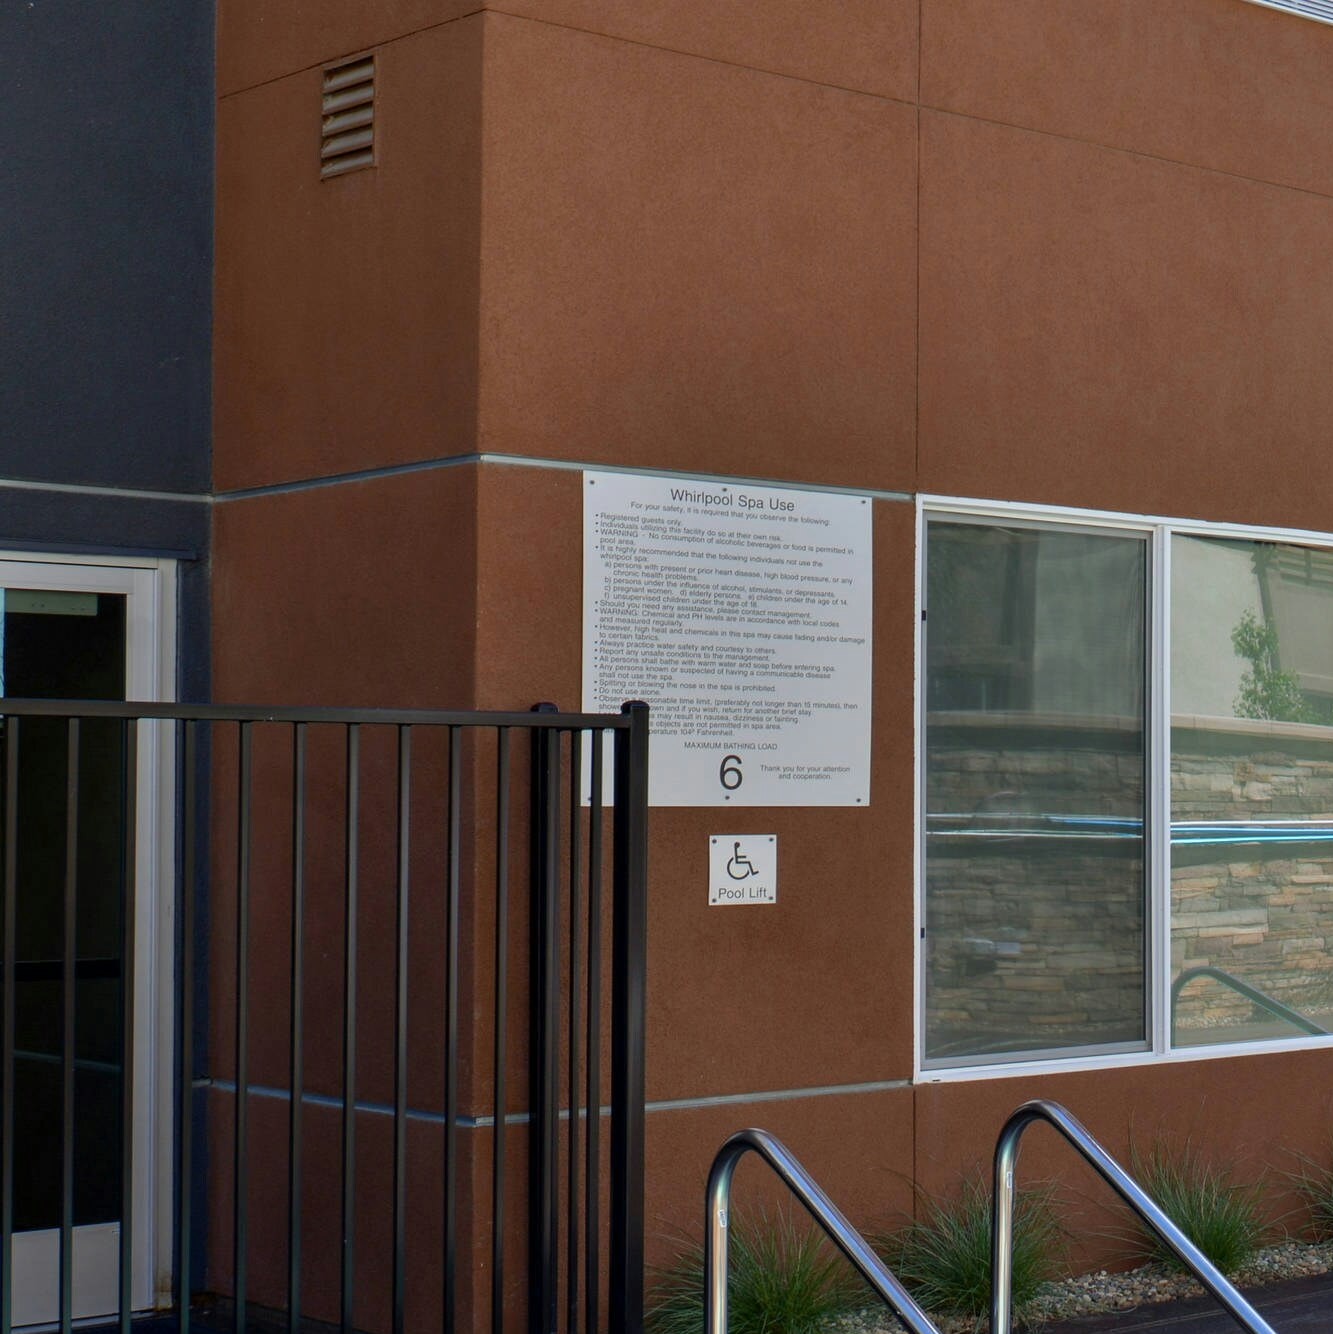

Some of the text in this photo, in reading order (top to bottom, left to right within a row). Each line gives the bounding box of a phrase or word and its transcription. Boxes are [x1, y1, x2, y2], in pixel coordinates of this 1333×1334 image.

[670, 488, 794, 511] Whirlpool Spa Use
[719, 754, 742, 790] 6
[718, 887, 767, 899] Pool Lift
